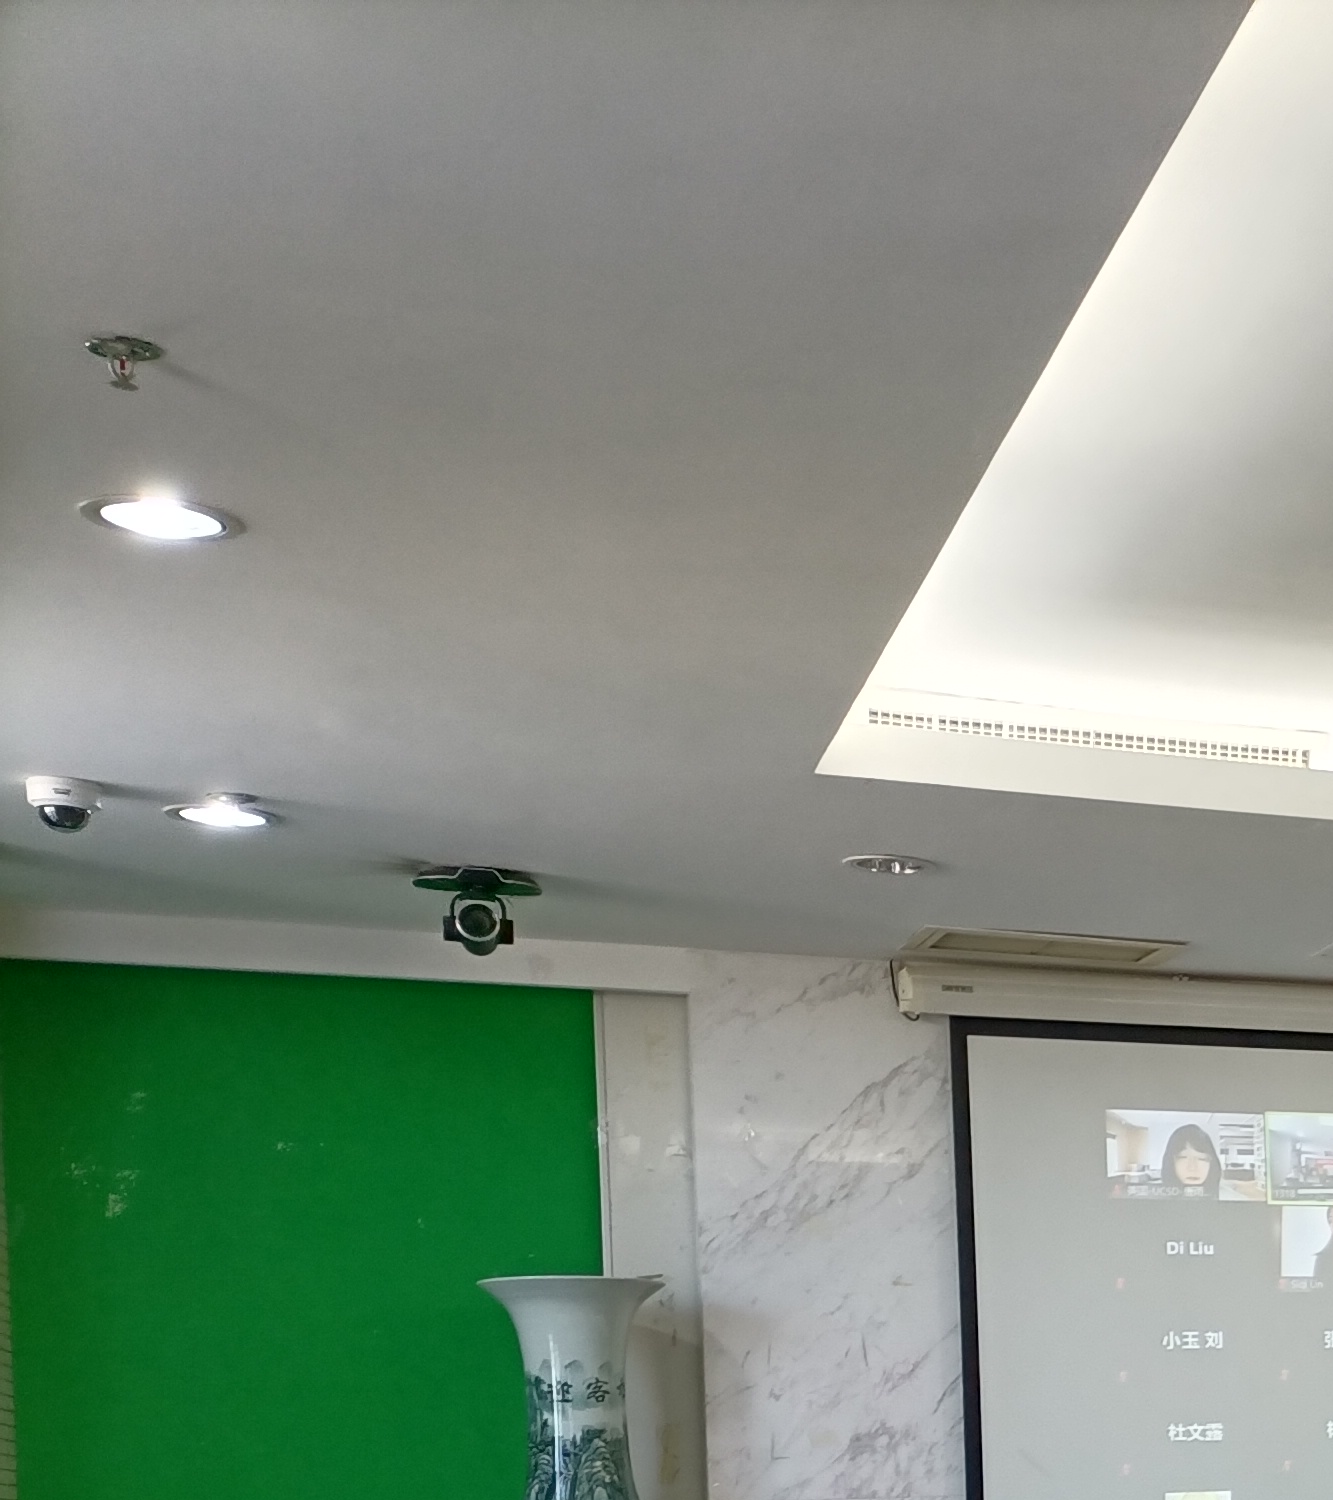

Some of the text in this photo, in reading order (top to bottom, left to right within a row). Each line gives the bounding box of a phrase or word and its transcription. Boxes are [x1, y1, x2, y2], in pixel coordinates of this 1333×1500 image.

[1166, 1241, 1215, 1255] Di Liu
[1162, 1330, 1224, 1350] 小玉 刘
